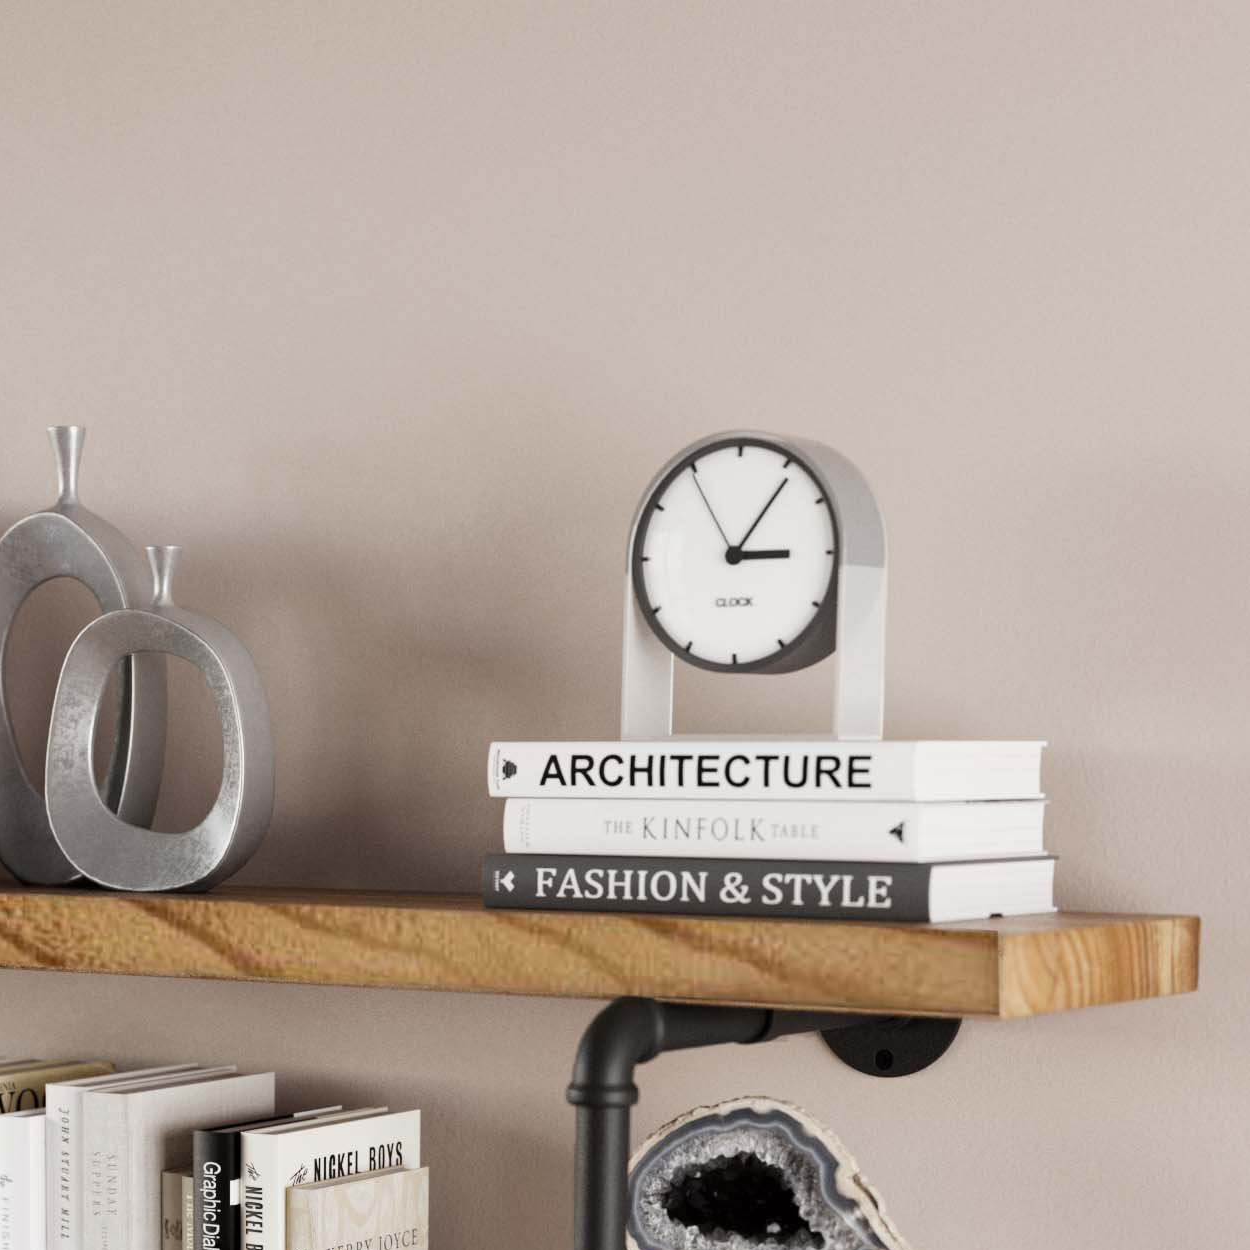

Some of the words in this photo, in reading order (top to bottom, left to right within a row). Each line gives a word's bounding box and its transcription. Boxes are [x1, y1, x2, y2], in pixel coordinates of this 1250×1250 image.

[715, 597, 752, 608] CLOCK
[540, 753, 872, 788] ARCHITECTURE
[604, 819, 633, 835] THE
[642, 816, 766, 842] KINFOLK
[770, 823, 820, 840] TABLE
[535, 867, 708, 902] FASHION
[718, 871, 751, 904] &
[761, 872, 893, 909] STYLE
[57, 1107, 71, 1144] JOHN
[60, 1151, 71, 1200] STUART
[314, 1151, 360, 1182] NICKEL
[369, 1141, 403, 1173] BOYS
[200, 1161, 222, 1221] Graphic
[245, 1186, 263, 1235] NICKEL
[60, 1208, 71, 1240] MILL
